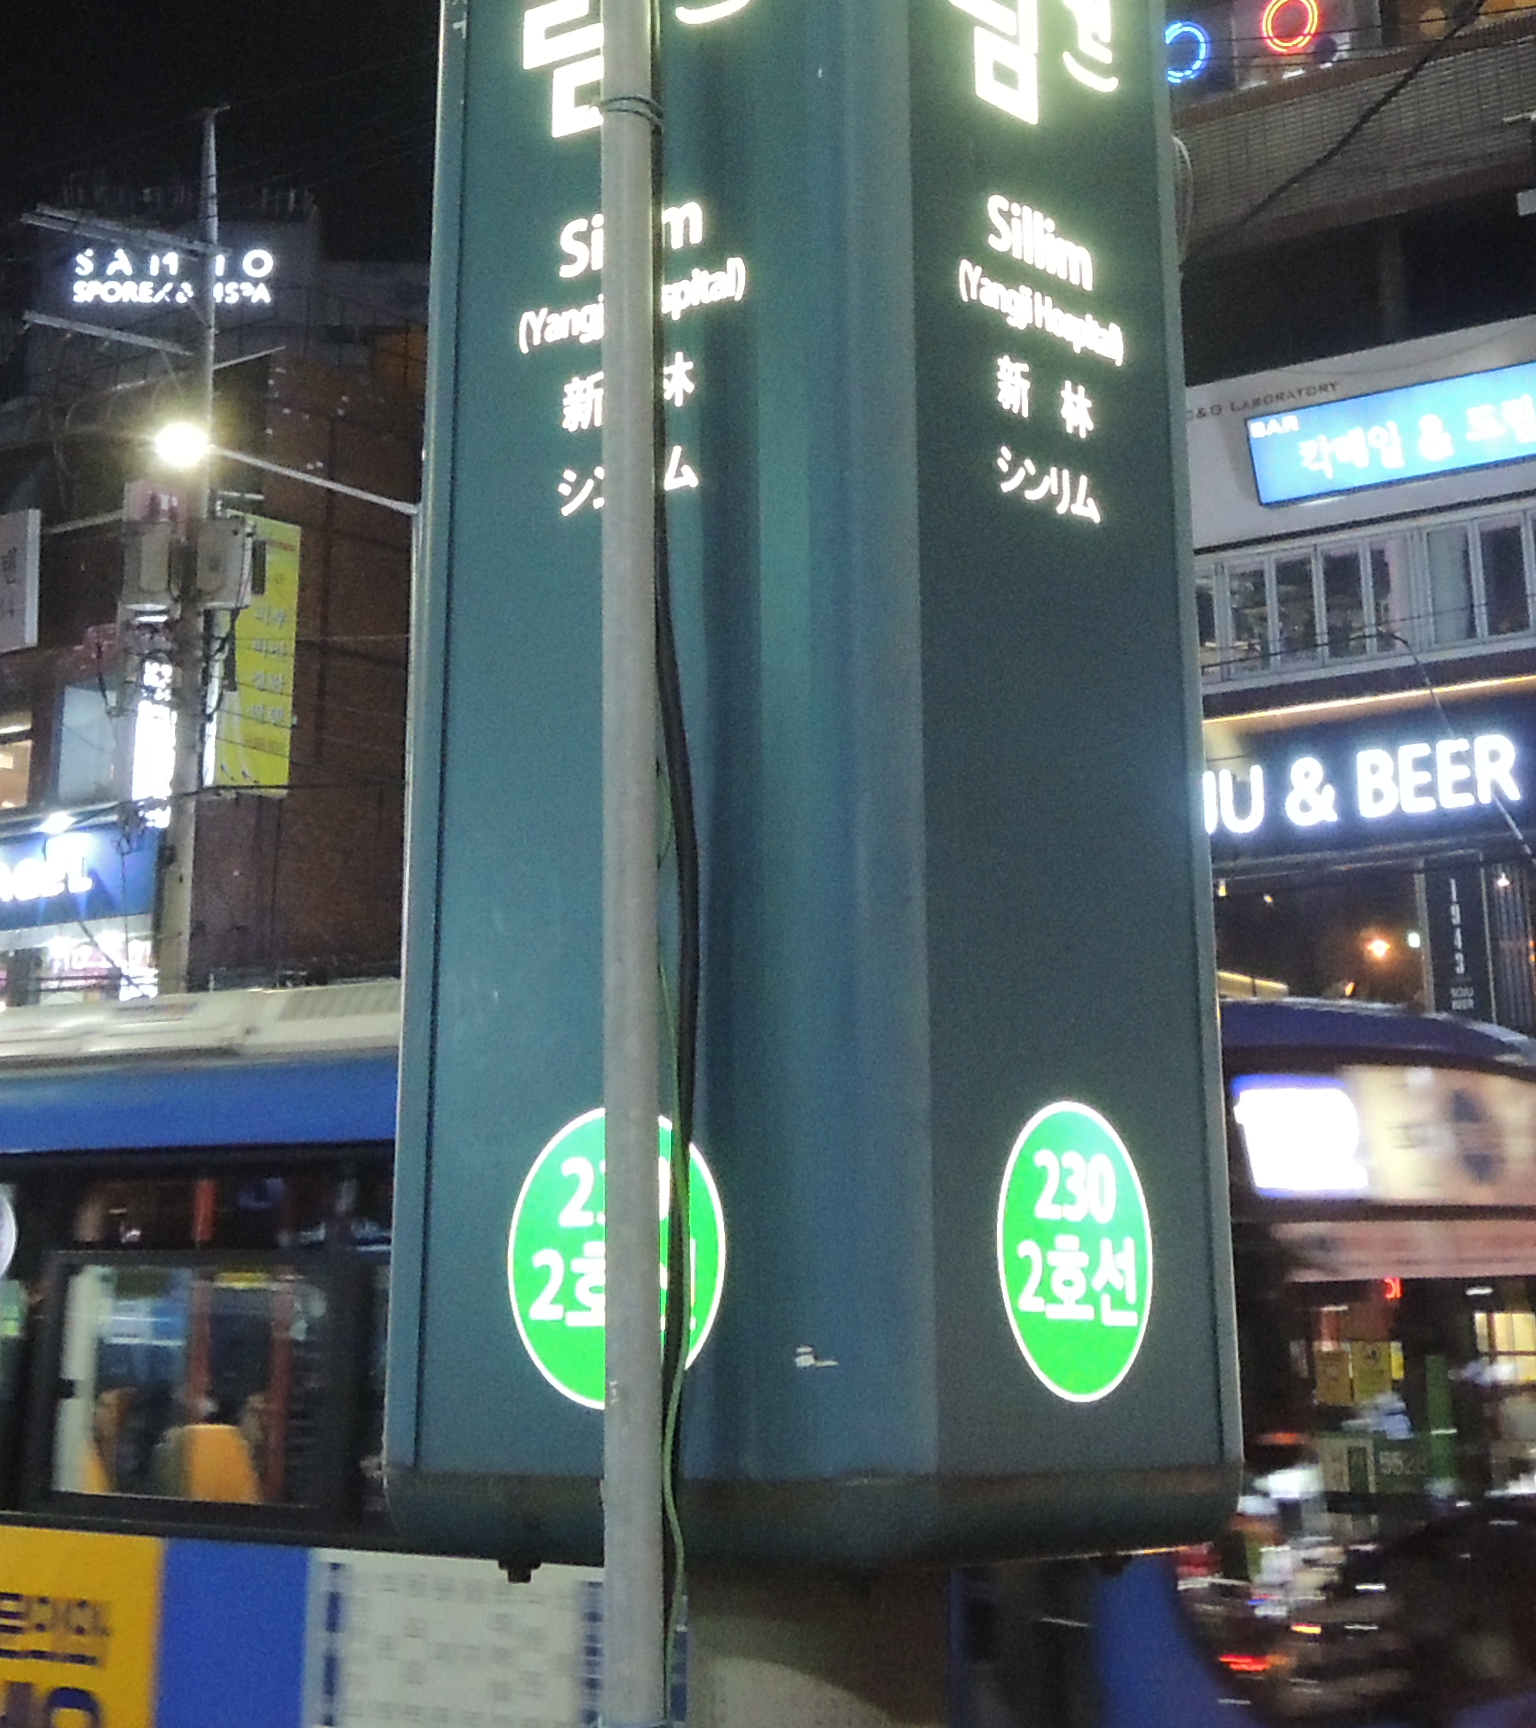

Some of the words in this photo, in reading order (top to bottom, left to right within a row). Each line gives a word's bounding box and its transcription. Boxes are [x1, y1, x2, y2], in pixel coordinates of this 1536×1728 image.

[986, 194, 1094, 291] Sillim
[995, 354, 1095, 439] 新林
[1230, 380, 1340, 413] LABORATORY
[1250, 414, 1300, 439] BAR
[995, 445, 1101, 524] シンリム
[1284, 756, 1338, 828] &
[1356, 732, 1523, 819] BEER
[1033, 1148, 1117, 1224] 230
[1015, 1233, 1139, 1328] 2호선
